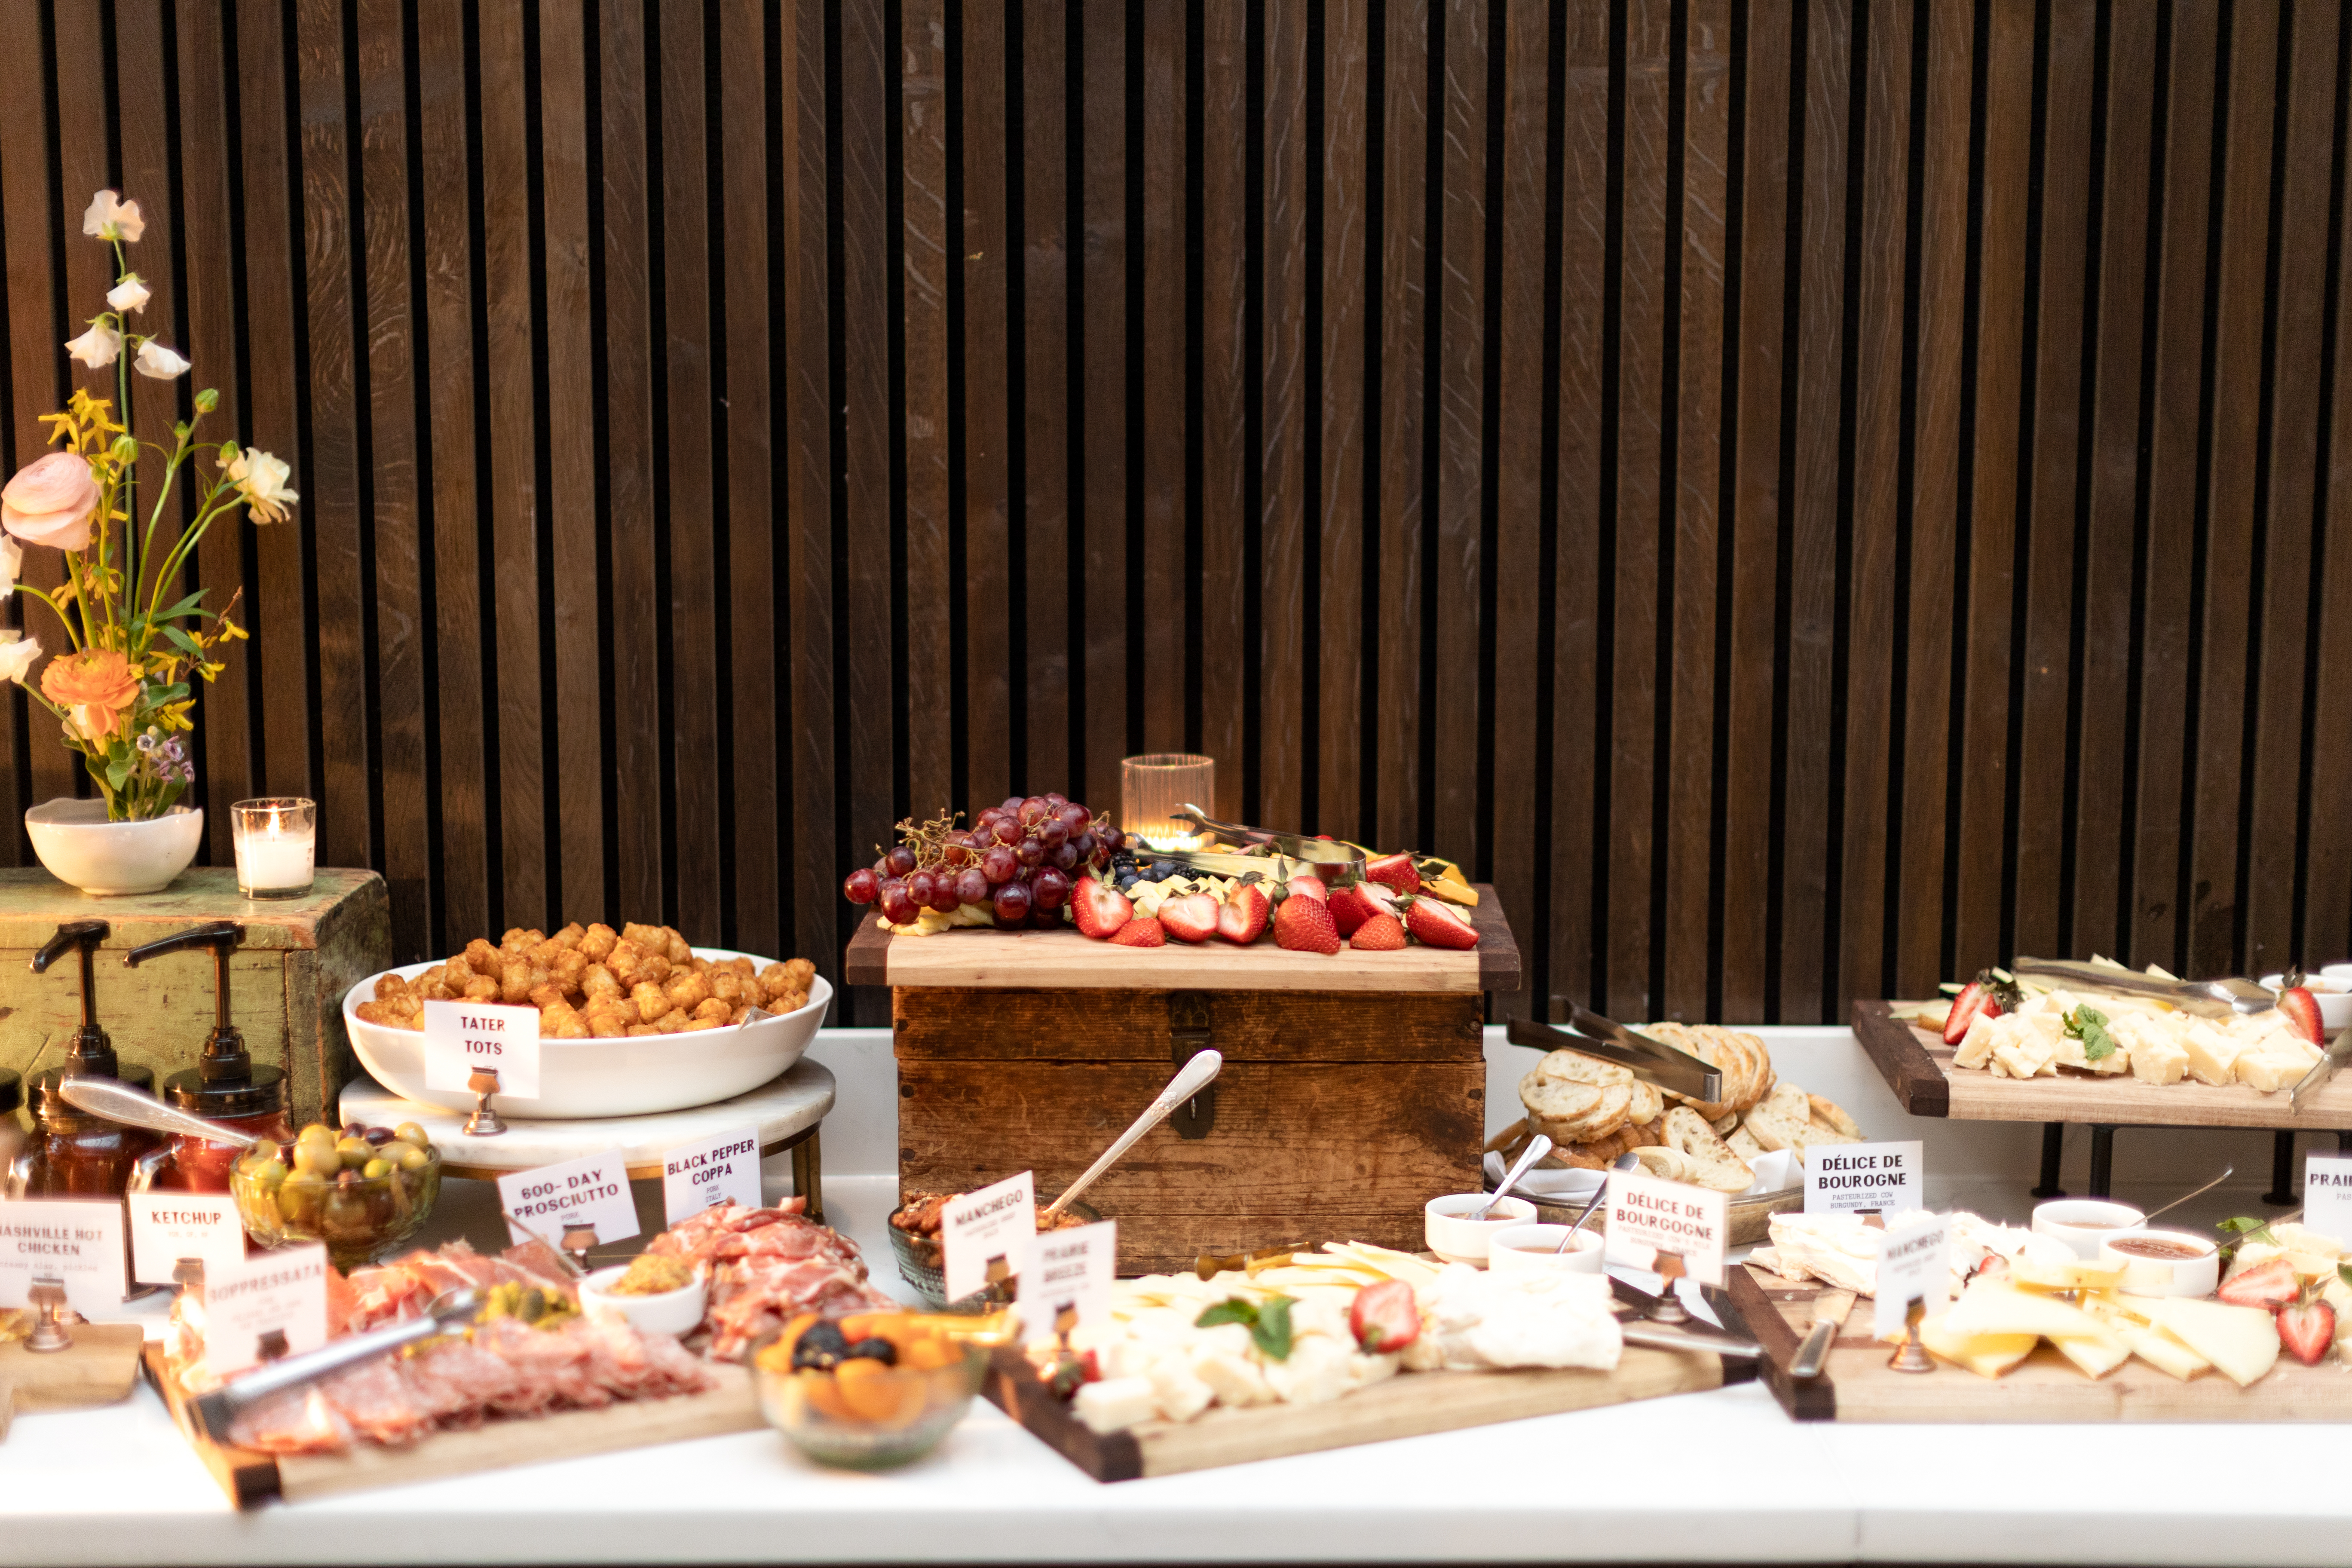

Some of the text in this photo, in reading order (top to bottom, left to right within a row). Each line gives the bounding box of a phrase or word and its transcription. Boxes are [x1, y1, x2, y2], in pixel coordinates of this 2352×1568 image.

[460, 1017, 505, 1032] TATER
[465, 1040, 502, 1055] TOTS
[668, 1139, 755, 1176] BLACK PEPPER
[1822, 1154, 1902, 1171] DÉLICE DE
[692, 1163, 732, 1185] COPPA
[1819, 1173, 1906, 1189] BOUROGNE
[521, 1169, 601, 1199] 600- DAY
[706, 1185, 720, 1194] PORK
[514, 1184, 619, 1217] PROSCIUTTO
[706, 1192, 722, 1203] ITALY
[1627, 1191, 1704, 1220] DÉLICE DE
[955, 1189, 1023, 1227] MANCHEGO
[152, 1211, 221, 1225] KETCHUP
[1617, 1209, 1713, 1241] BOURGOGNE
[0, 1225, 103, 1241] ASHVILLE HOT
[18, 1242, 80, 1256] CHICKEN
[208, 1264, 322, 1303] SOPPRESSATA
